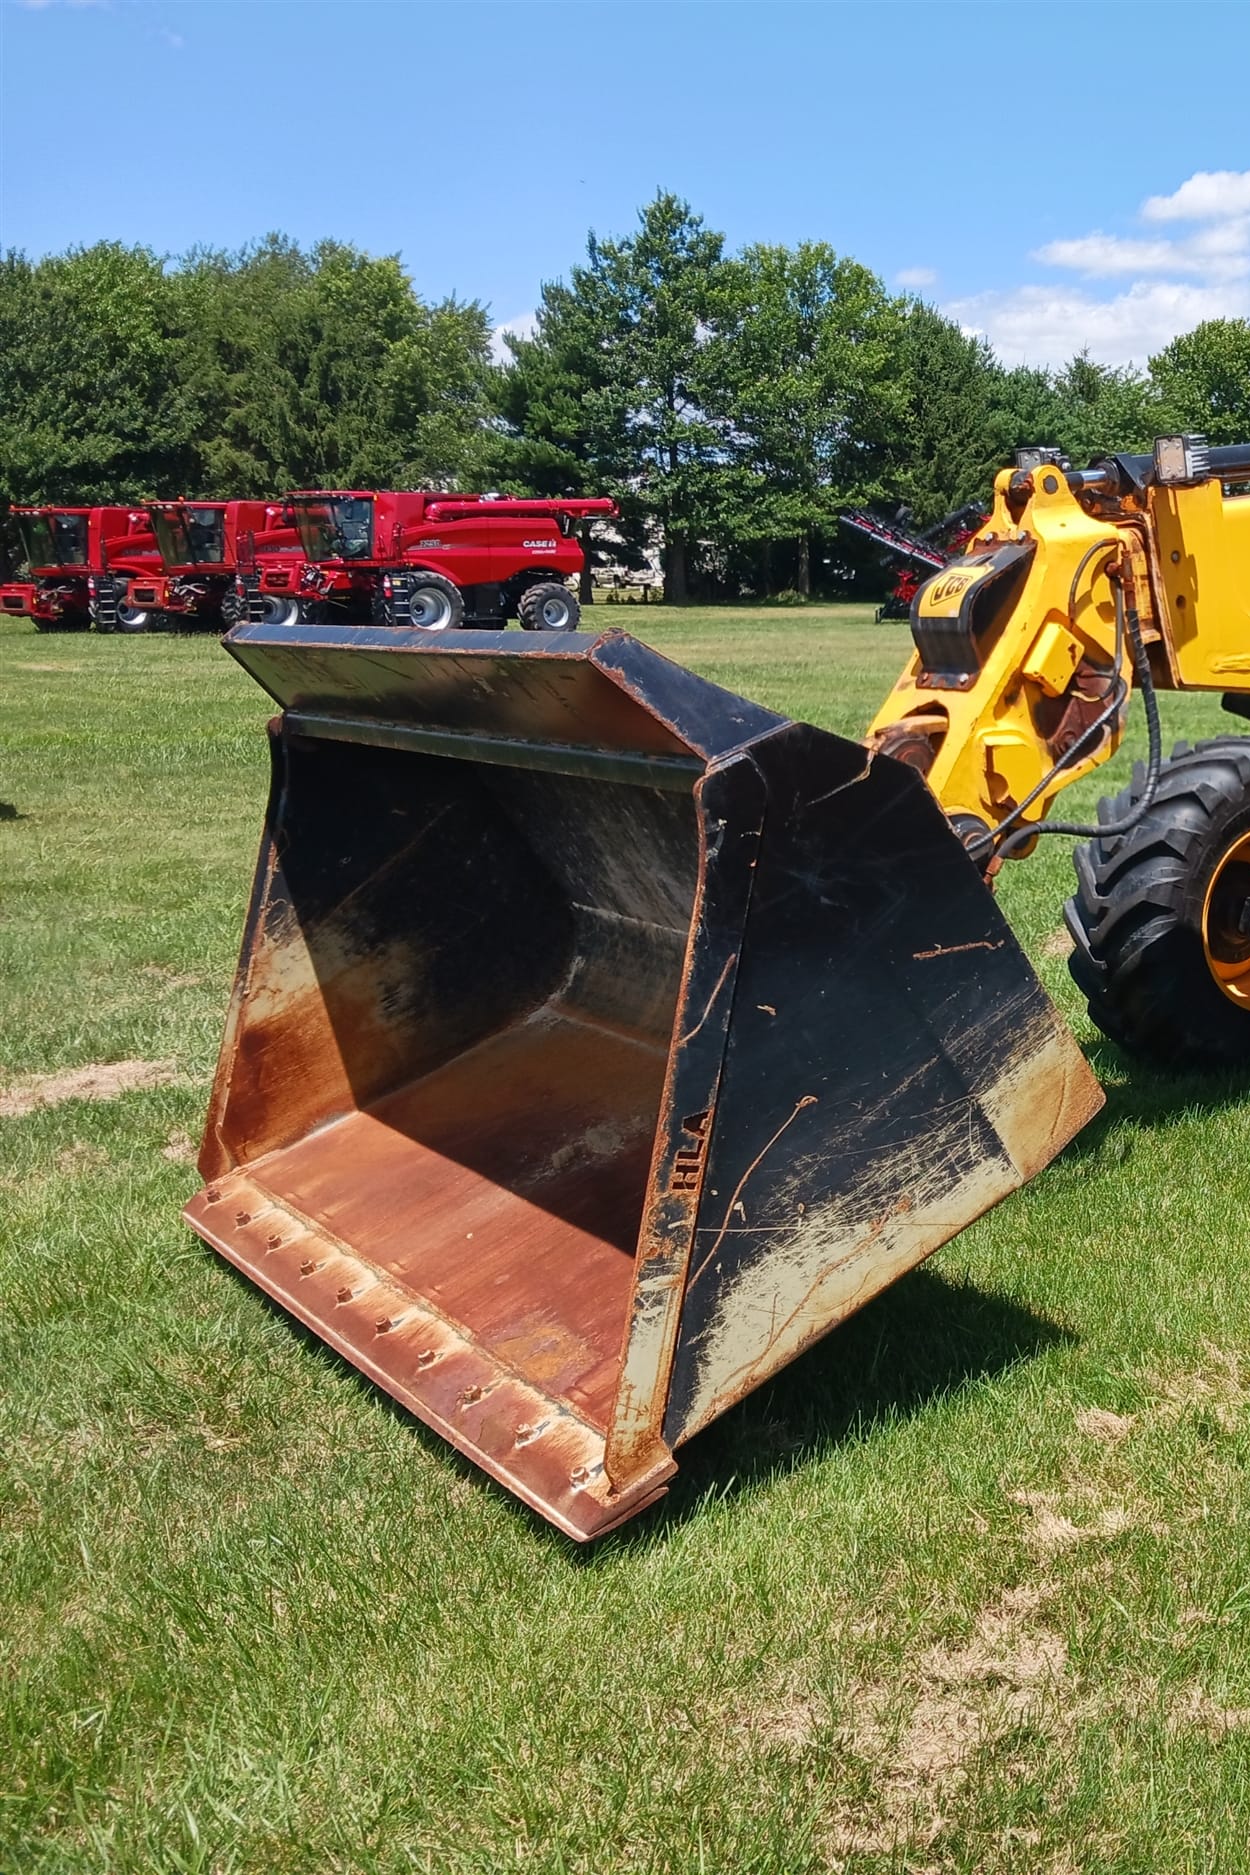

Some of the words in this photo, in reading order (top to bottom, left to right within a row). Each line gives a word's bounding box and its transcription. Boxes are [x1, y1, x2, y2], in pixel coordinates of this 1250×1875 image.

[523, 540, 547, 548] CASE
[934, 576, 969, 601] JCB
[671, 1109, 710, 1190] HLA
